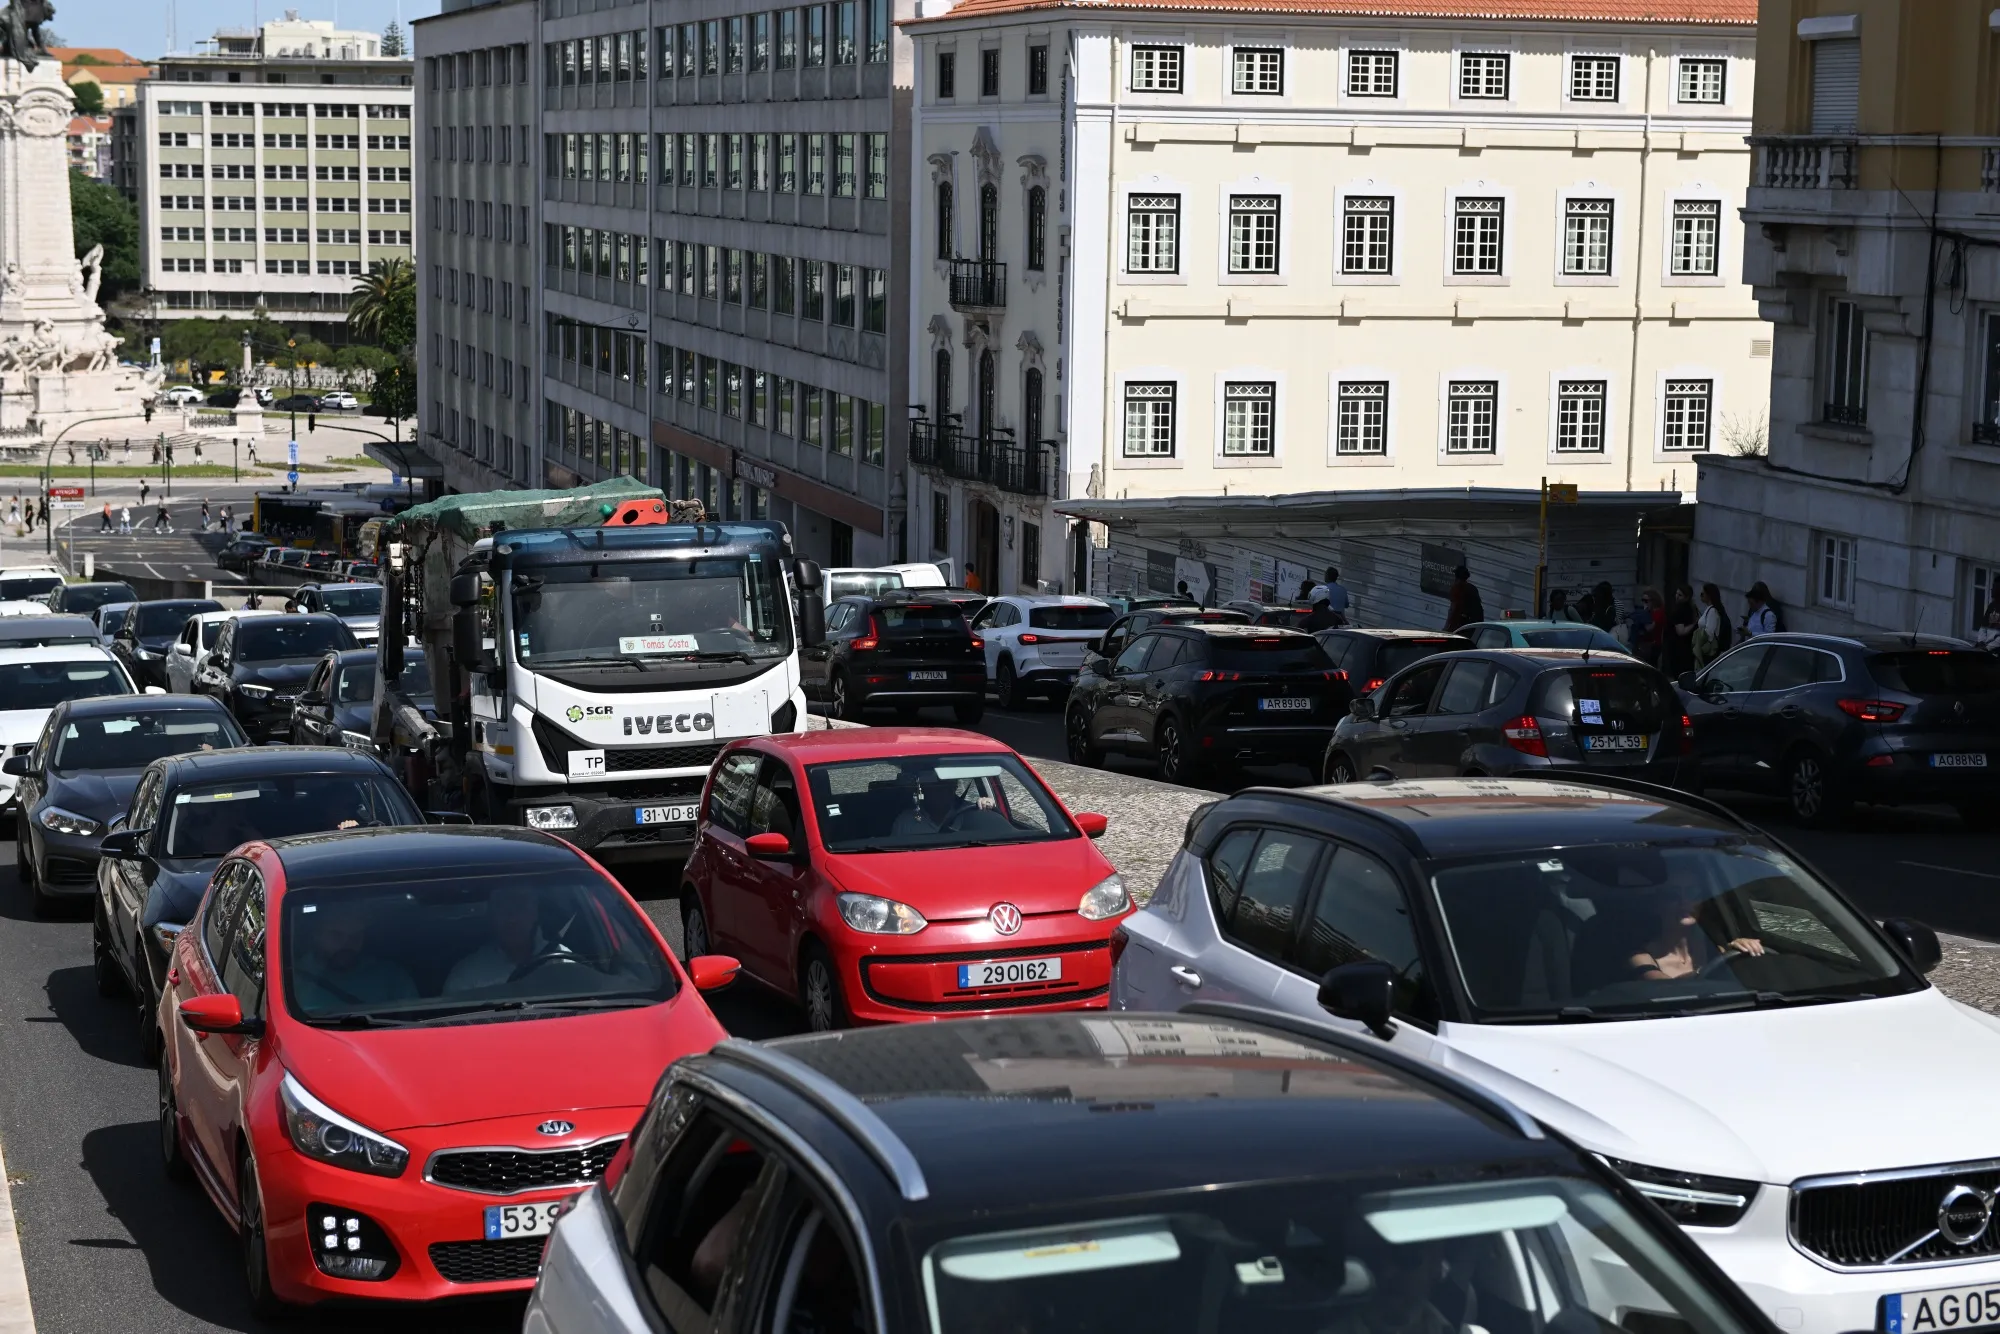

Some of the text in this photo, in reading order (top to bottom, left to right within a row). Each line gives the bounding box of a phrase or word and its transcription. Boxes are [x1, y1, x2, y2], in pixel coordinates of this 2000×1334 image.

[641, 637, 690, 650] Tomás Costa
[586, 705, 614, 715] SGR
[623, 712, 713, 736] IVECO
[584, 756, 604, 769] TP
[542, 1121, 571, 1133] KIA
[1948, 1211, 1985, 1221] VOLVO
[490, 1225, 497, 1233] P
[1890, 1319, 1897, 1329] P
